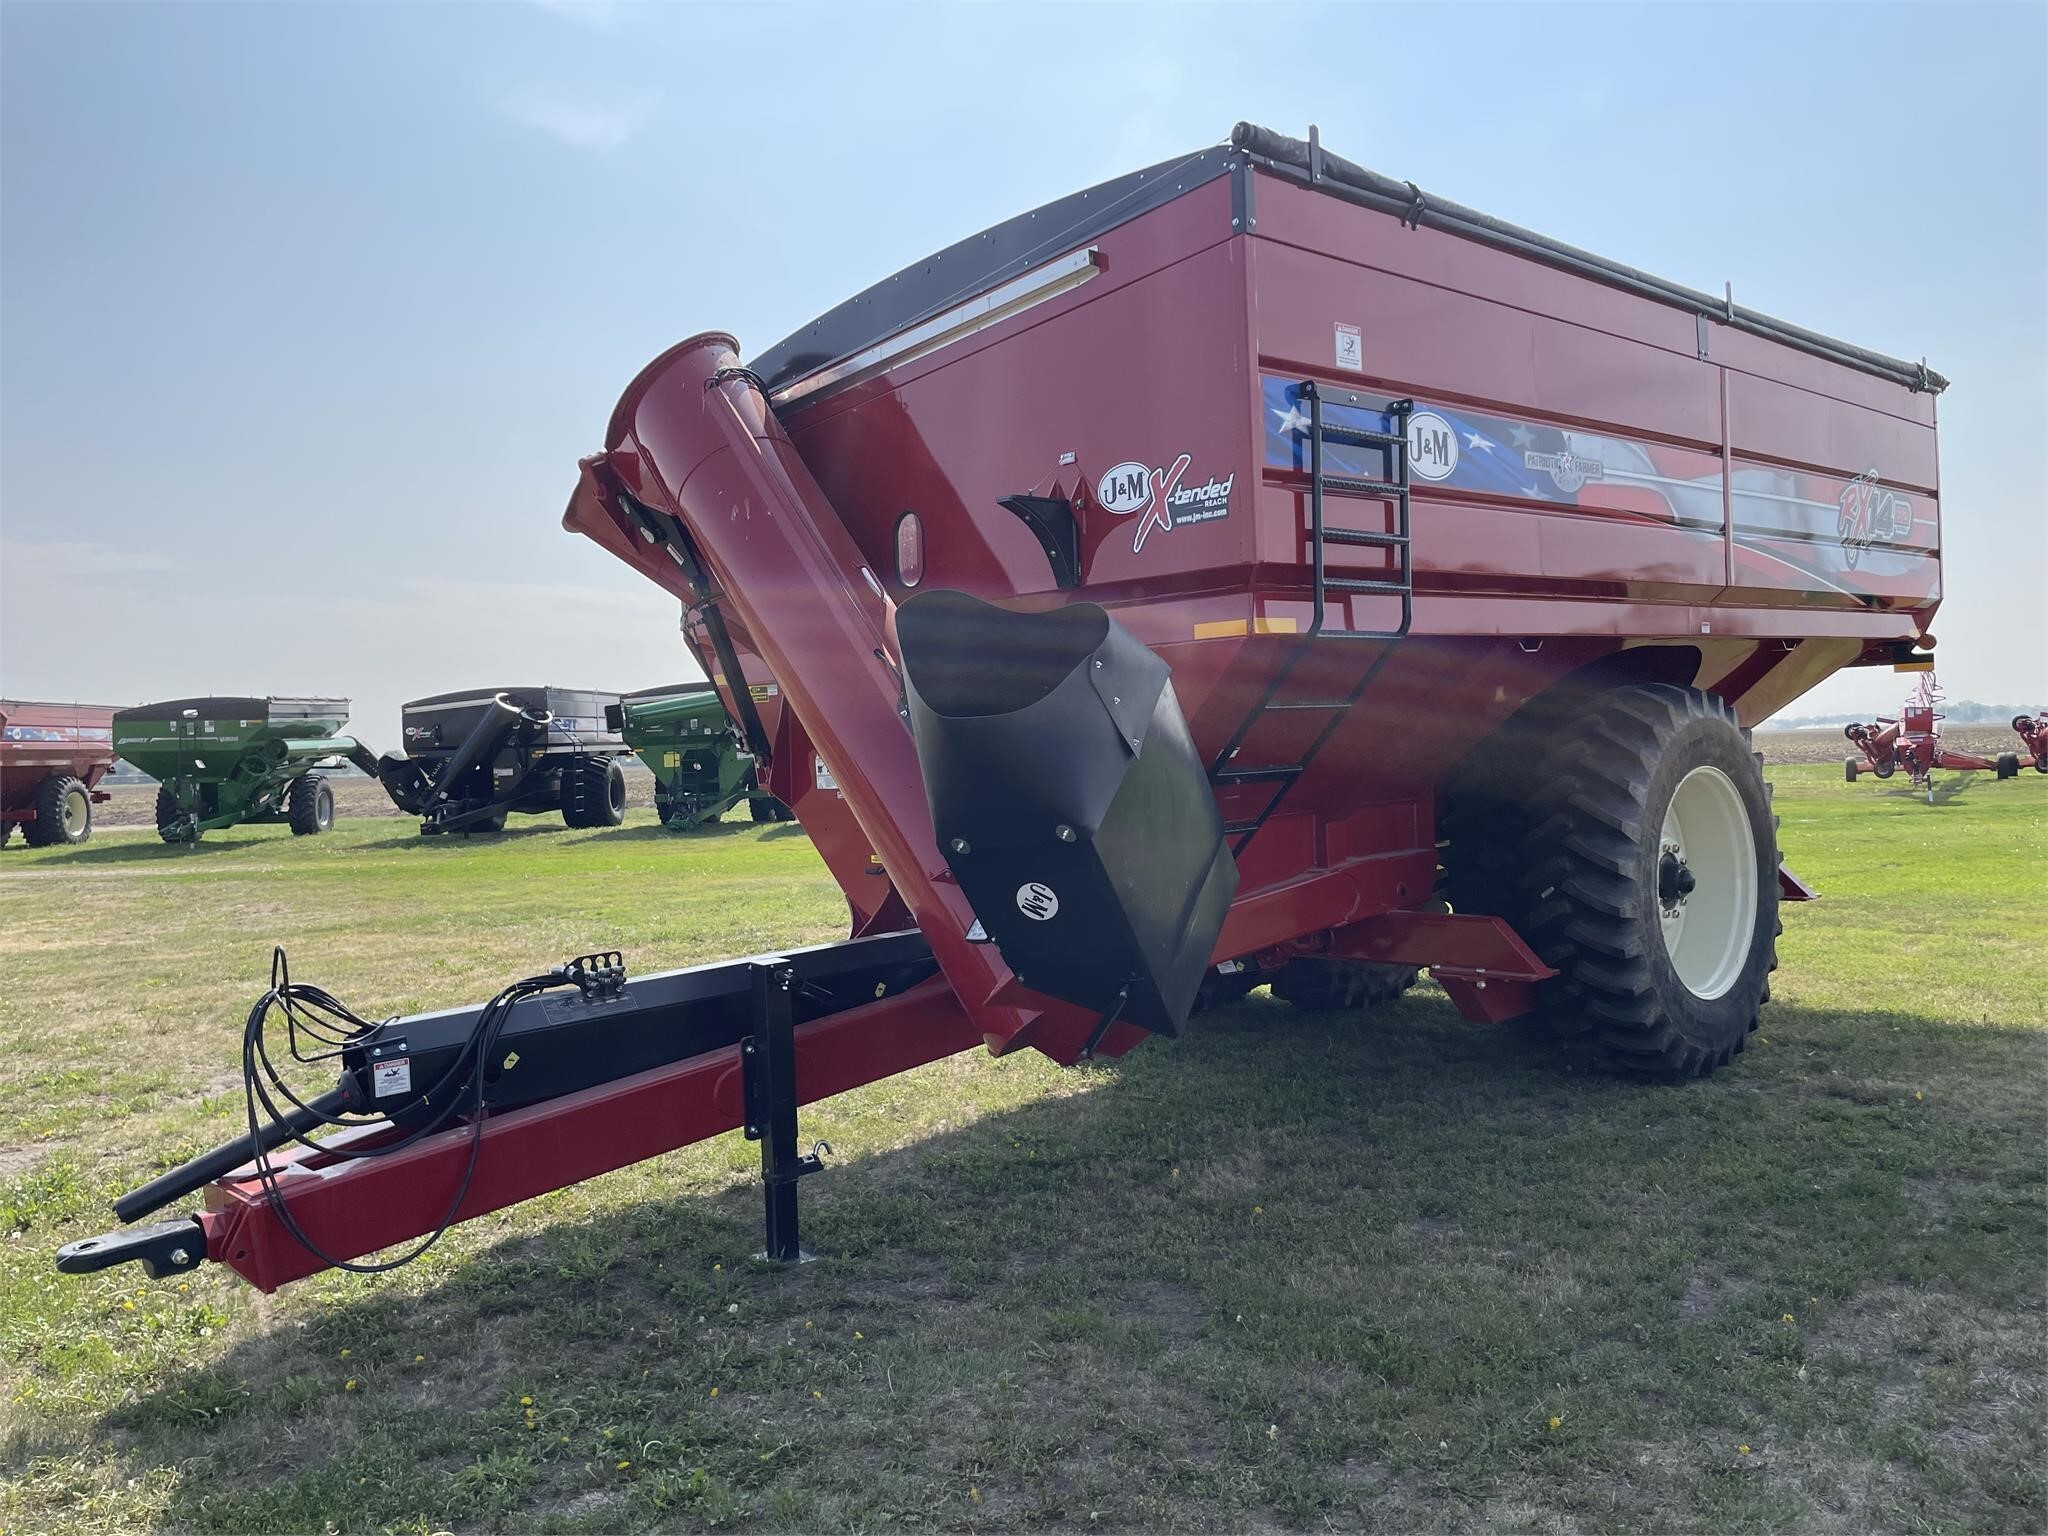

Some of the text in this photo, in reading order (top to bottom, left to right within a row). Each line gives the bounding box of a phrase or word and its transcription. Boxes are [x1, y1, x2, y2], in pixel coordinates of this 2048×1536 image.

[1409, 426, 1449, 467] J&M
[1575, 459, 1600, 474] FARMER
[1103, 471, 1145, 505] J&M
[1204, 497, 1228, 508] REACH
[1176, 508, 1228, 524] www.jm-inc.com
[1021, 883, 1054, 919] J&M
